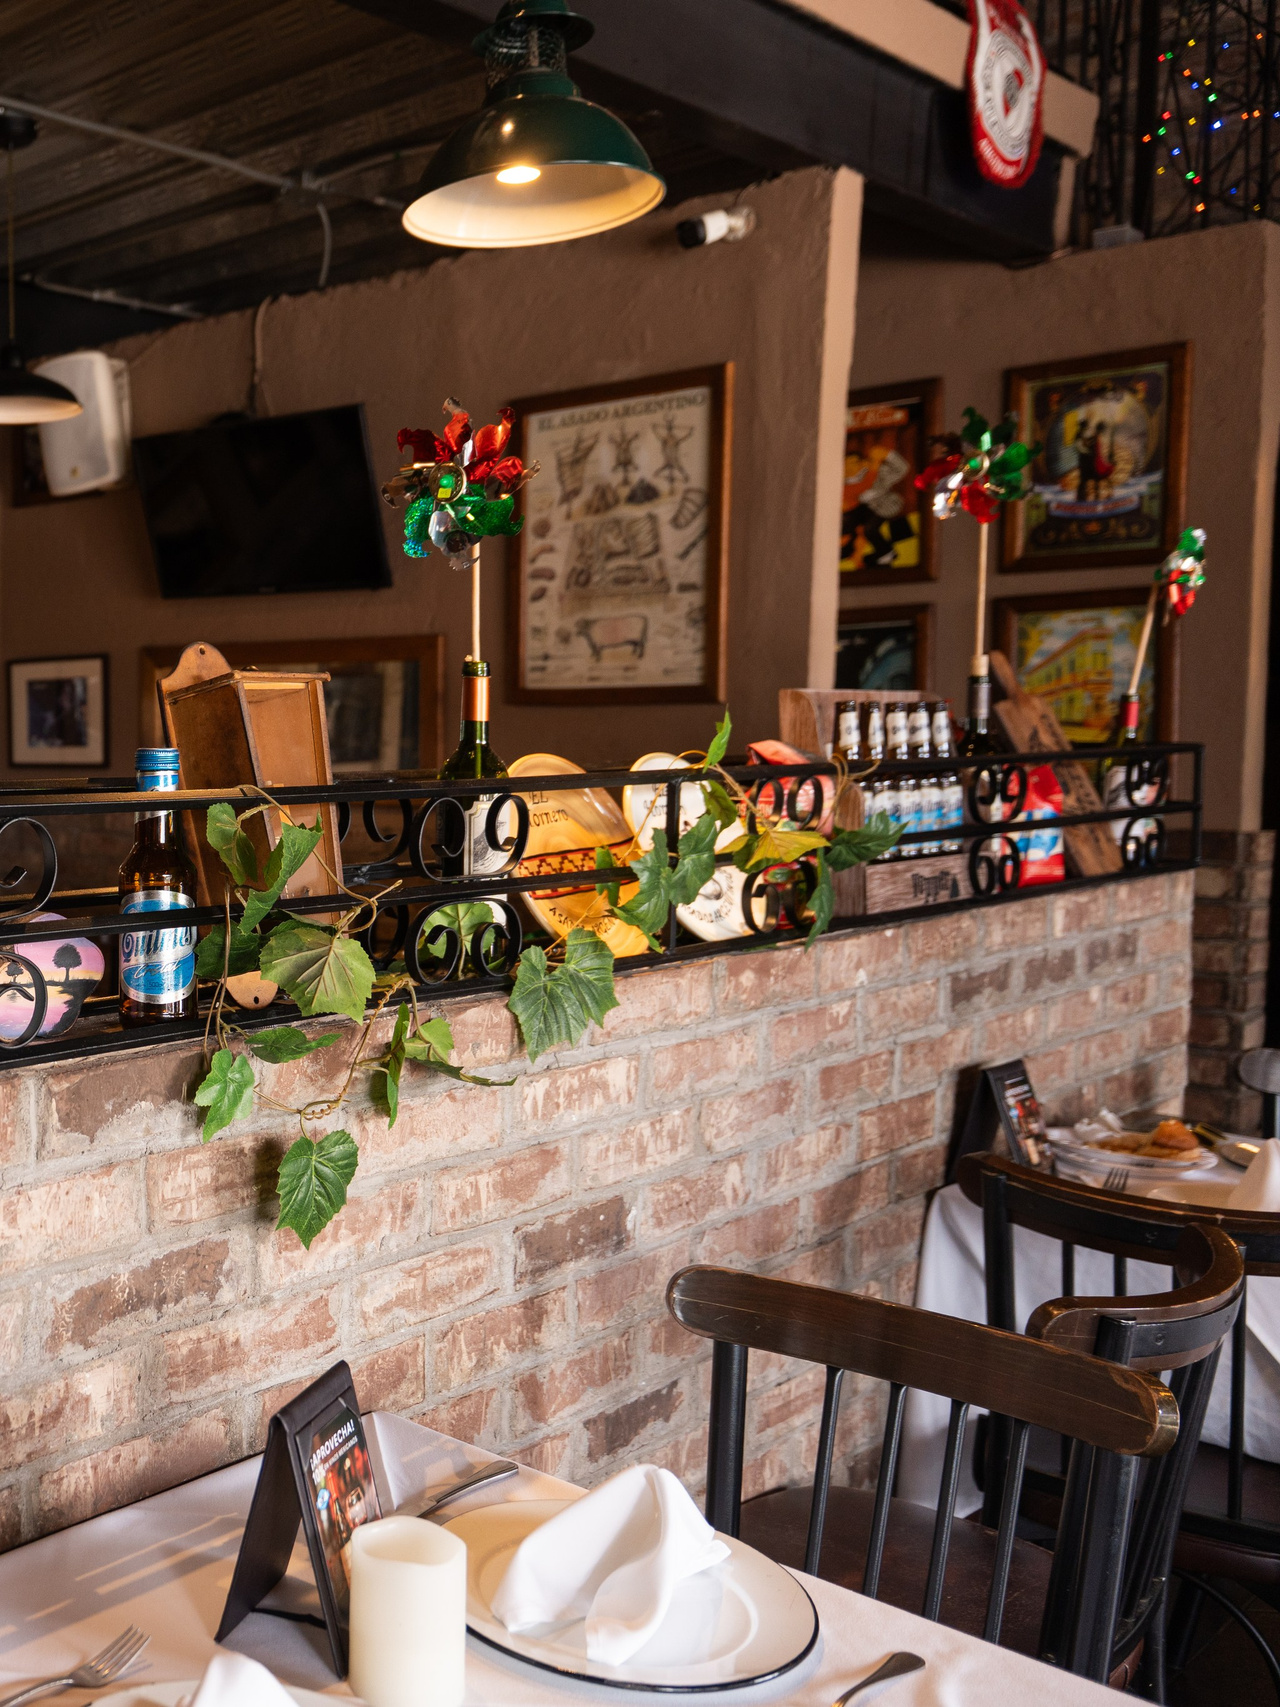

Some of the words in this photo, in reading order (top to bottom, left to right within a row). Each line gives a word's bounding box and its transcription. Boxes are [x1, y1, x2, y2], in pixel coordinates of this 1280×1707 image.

[559, 406, 609, 428] ASADO
[610, 392, 706, 419] ARGENTINO
[529, 809, 569, 827] ornero
[310, 1418, 355, 1471] ¡APROVECHA!
